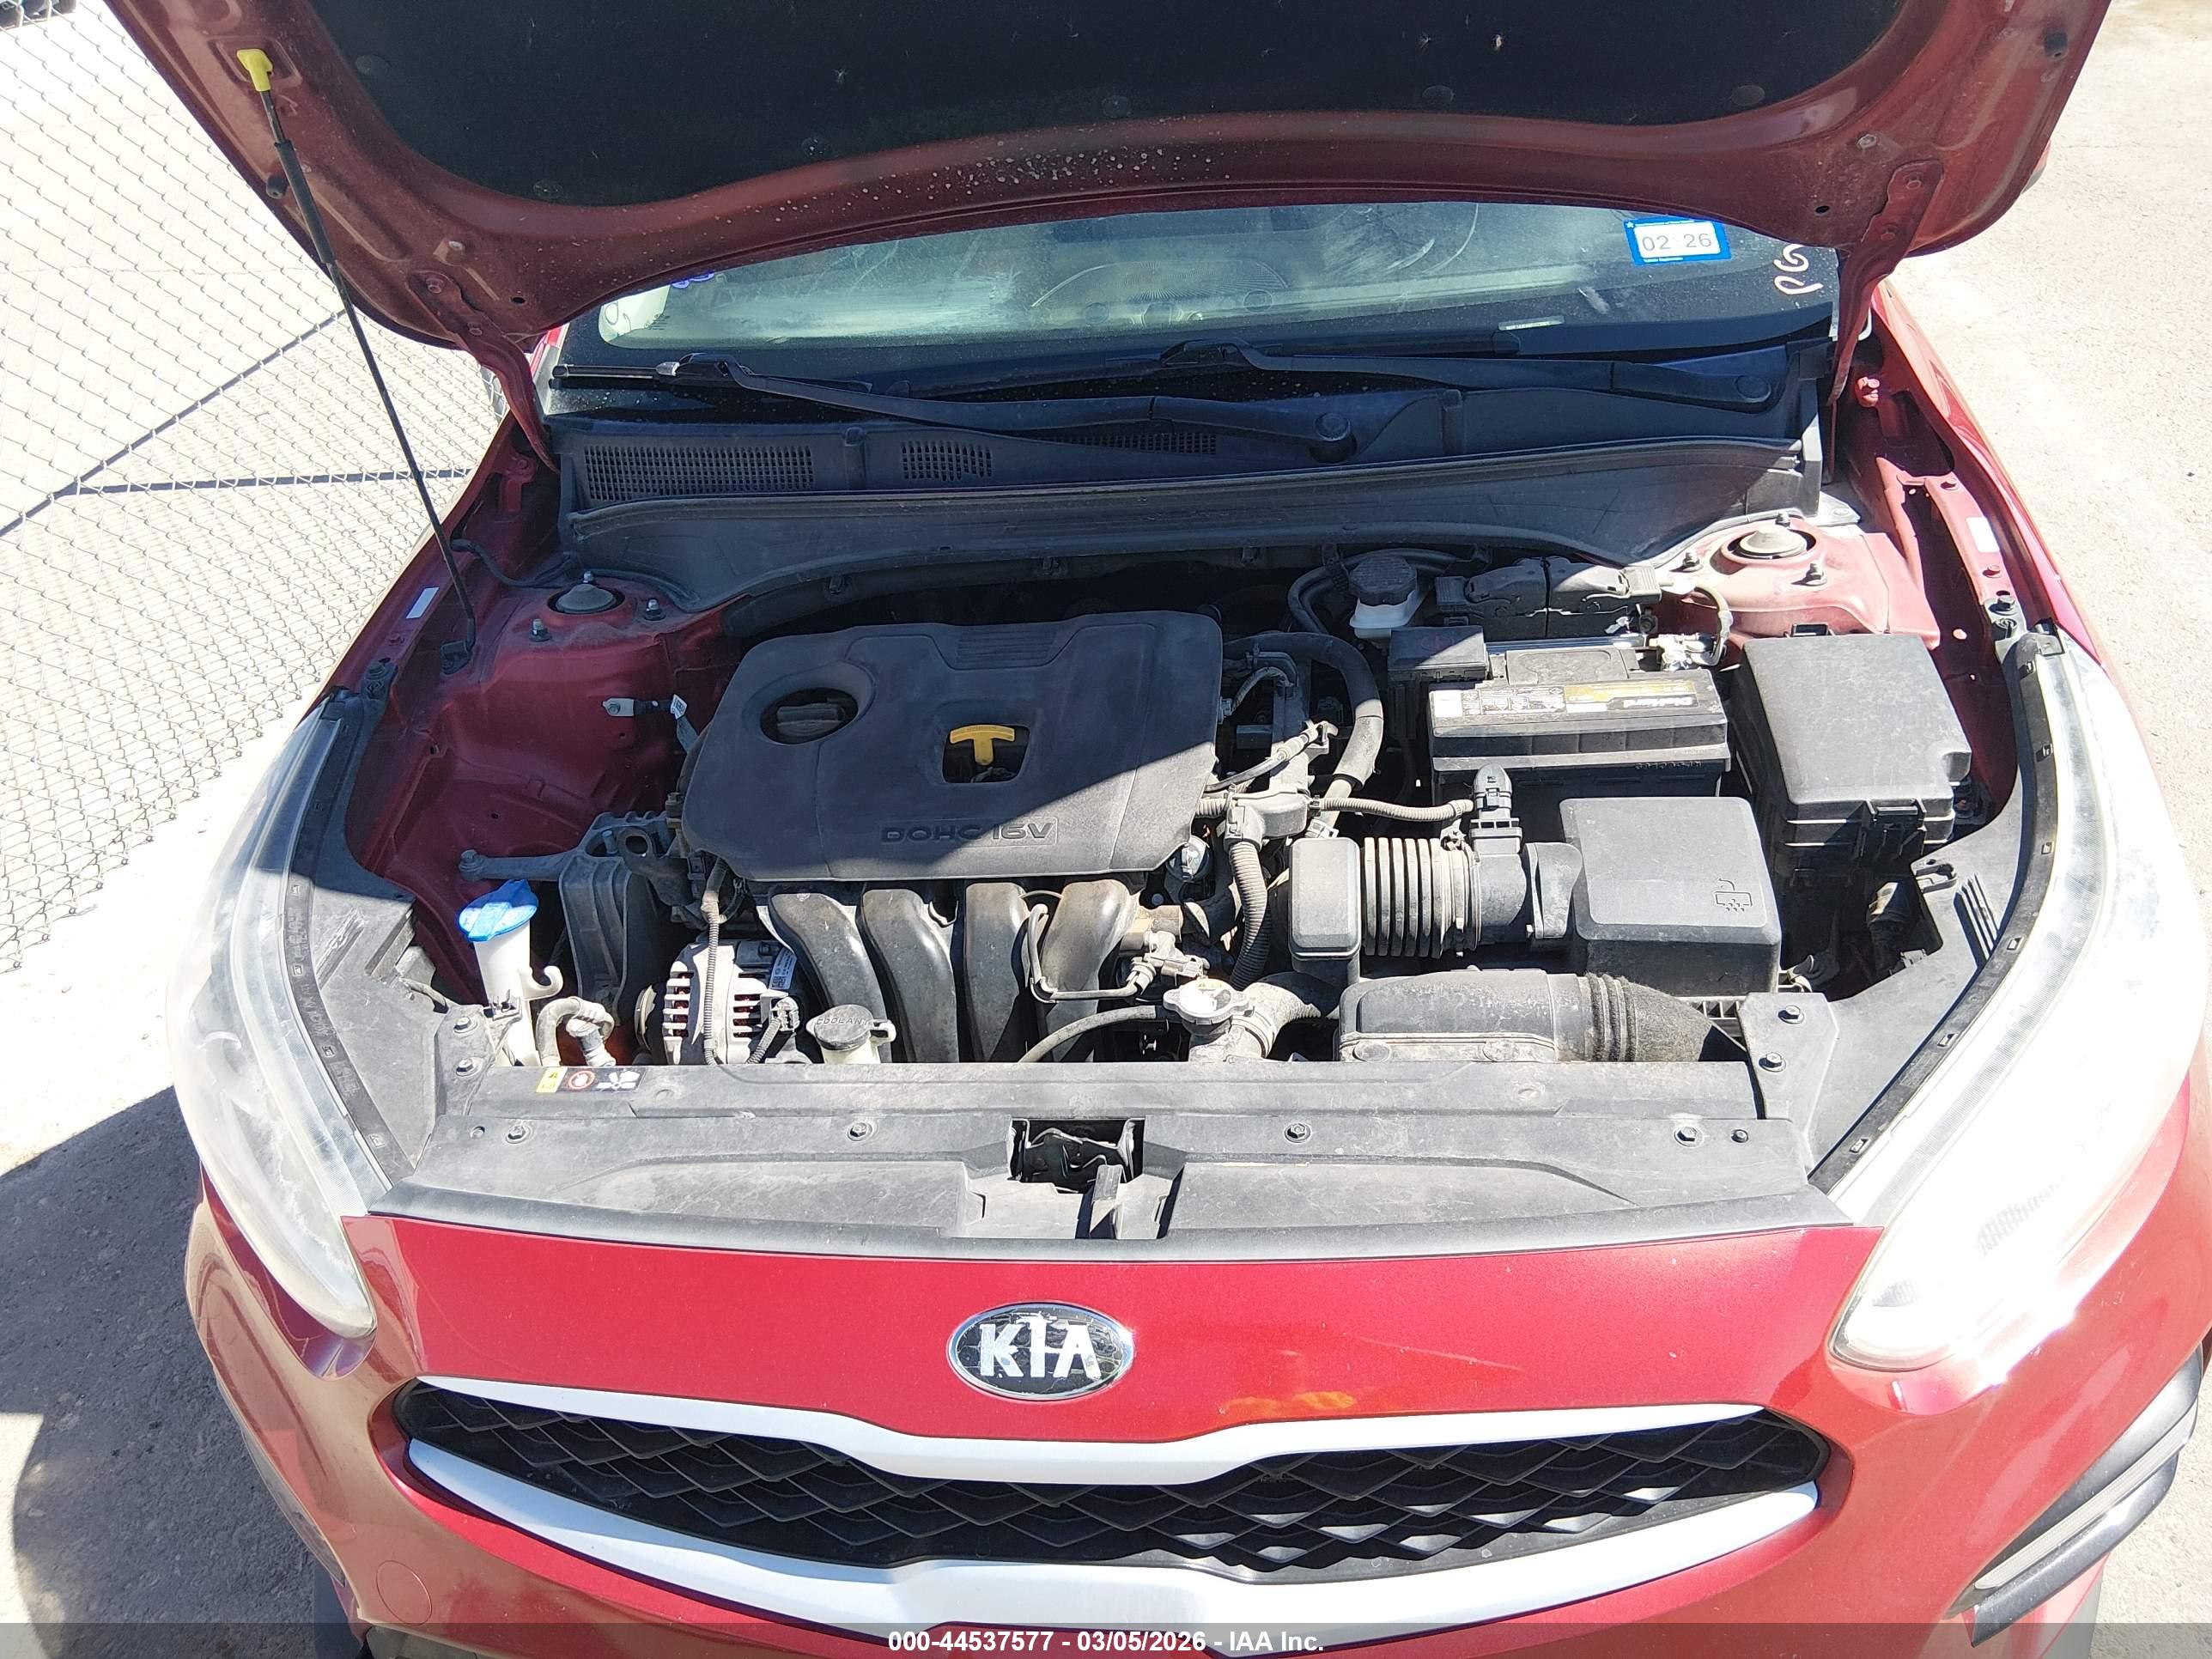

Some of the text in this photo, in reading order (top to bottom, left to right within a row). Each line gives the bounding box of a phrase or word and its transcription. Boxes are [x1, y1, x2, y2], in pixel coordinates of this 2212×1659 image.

[1642, 233, 1711, 252] 02 26
[881, 822, 1052, 843] DOHC 16V
[979, 1317, 1102, 1380] KIA
